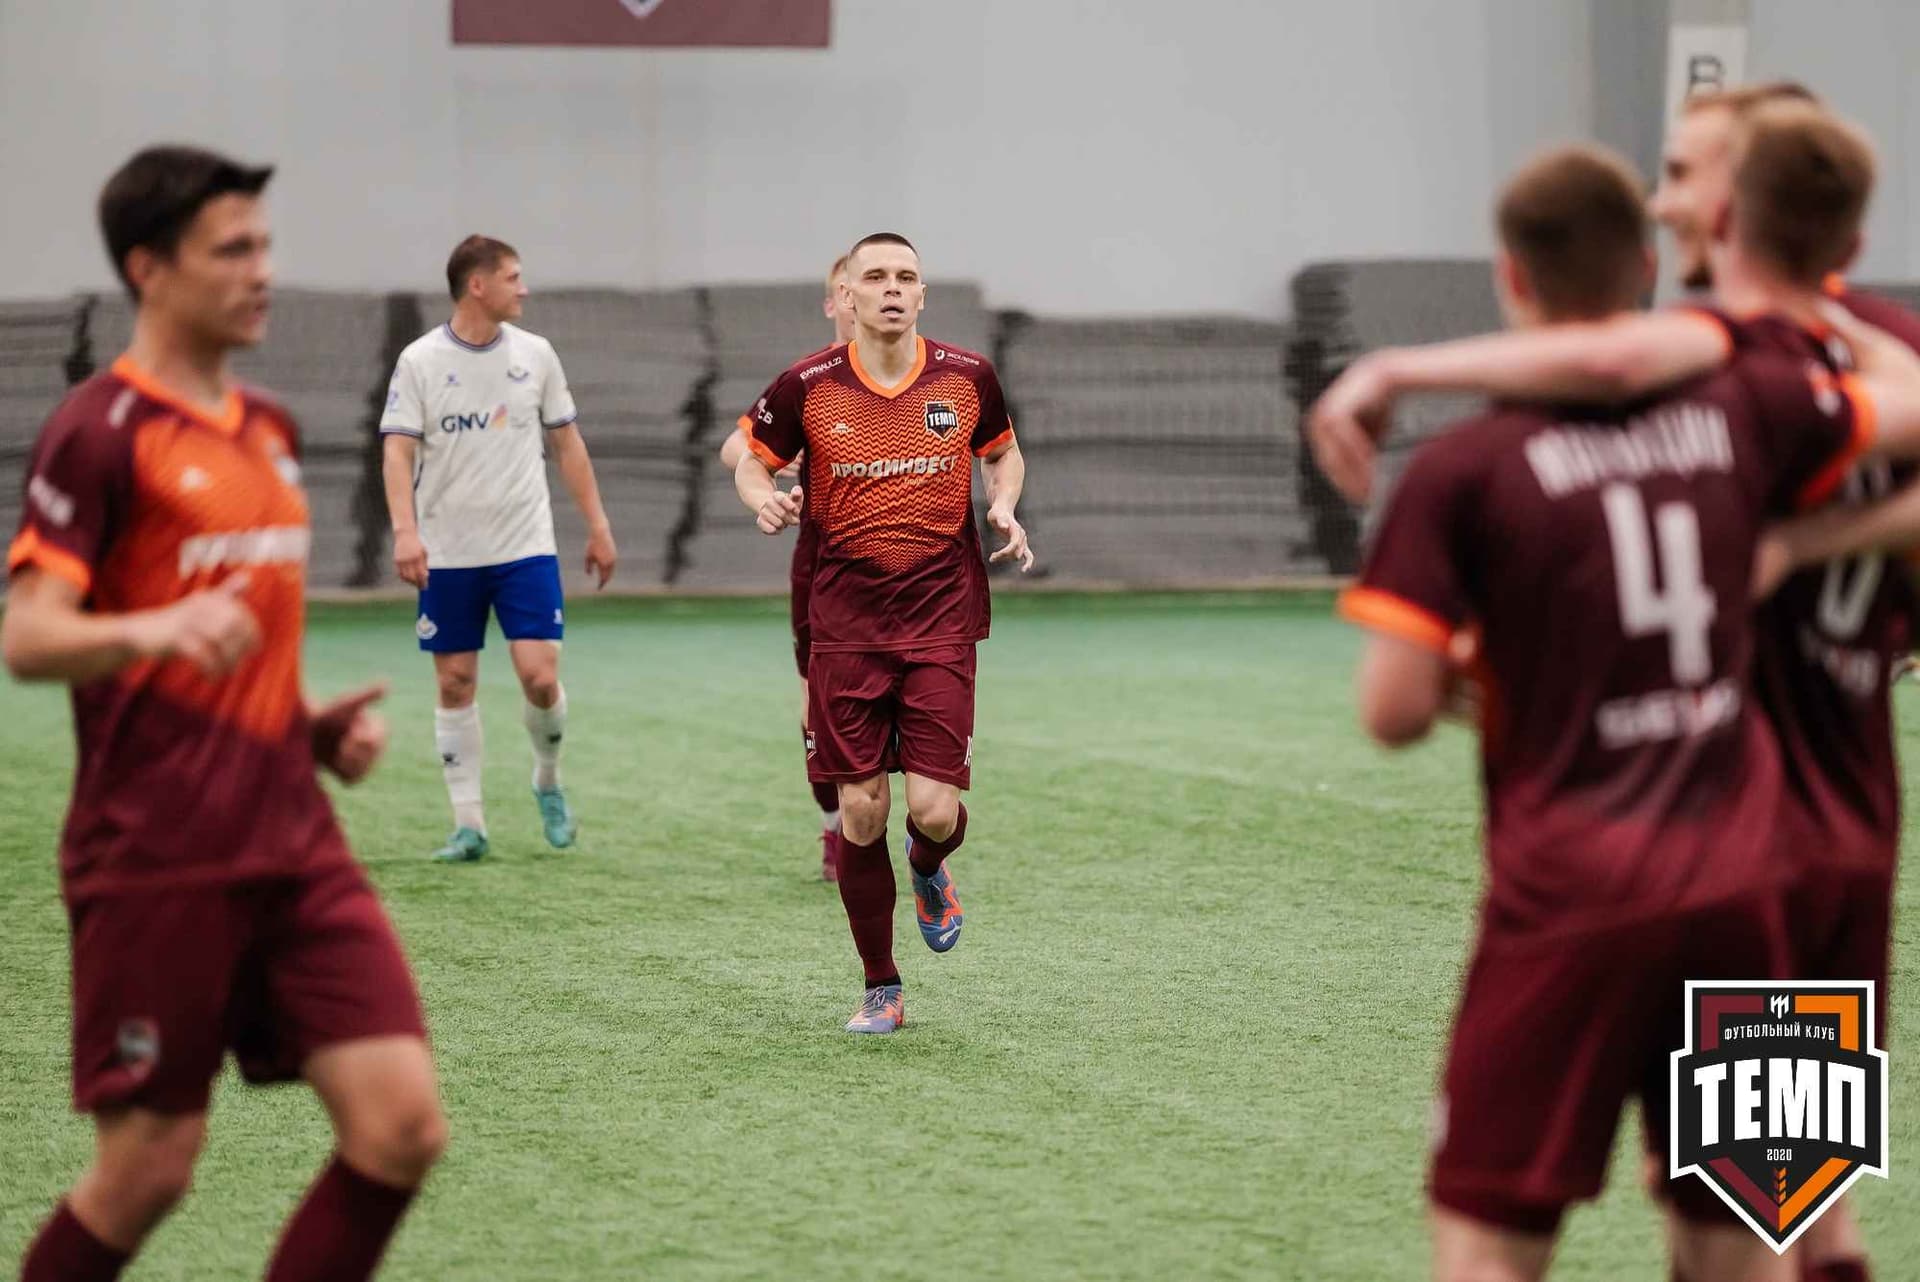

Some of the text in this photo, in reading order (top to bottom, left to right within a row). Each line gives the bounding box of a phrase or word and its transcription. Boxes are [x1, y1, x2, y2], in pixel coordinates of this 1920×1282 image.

[441, 412, 489, 433] GNV
[928, 411, 956, 427] ТЕМП
[1603, 480, 1718, 686] 4
